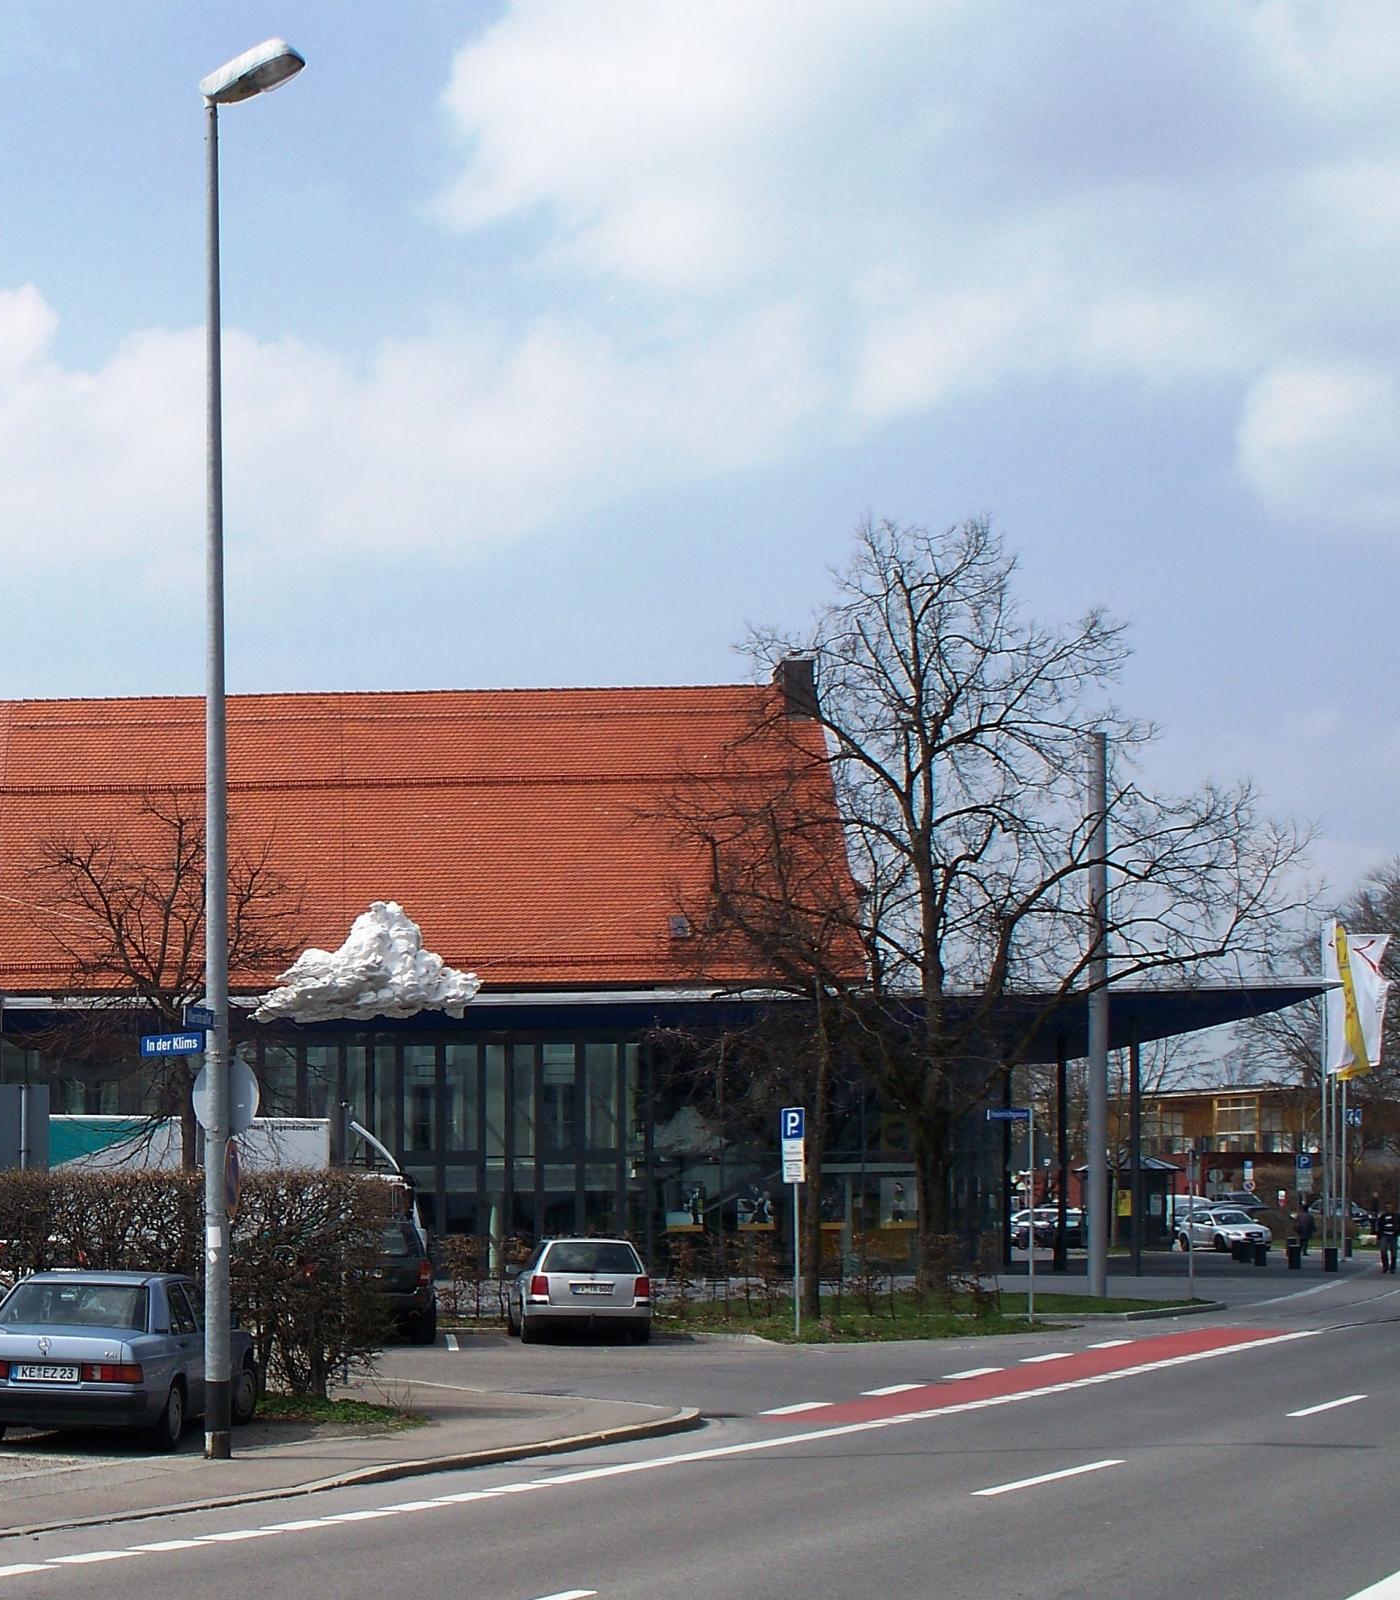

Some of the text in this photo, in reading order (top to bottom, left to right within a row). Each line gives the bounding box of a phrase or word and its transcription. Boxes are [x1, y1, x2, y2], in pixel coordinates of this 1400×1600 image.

[146, 1036, 198, 1051] In der Klims
[787, 1112, 800, 1136] P
[21, 1366, 74, 1380] KE EZ 23
